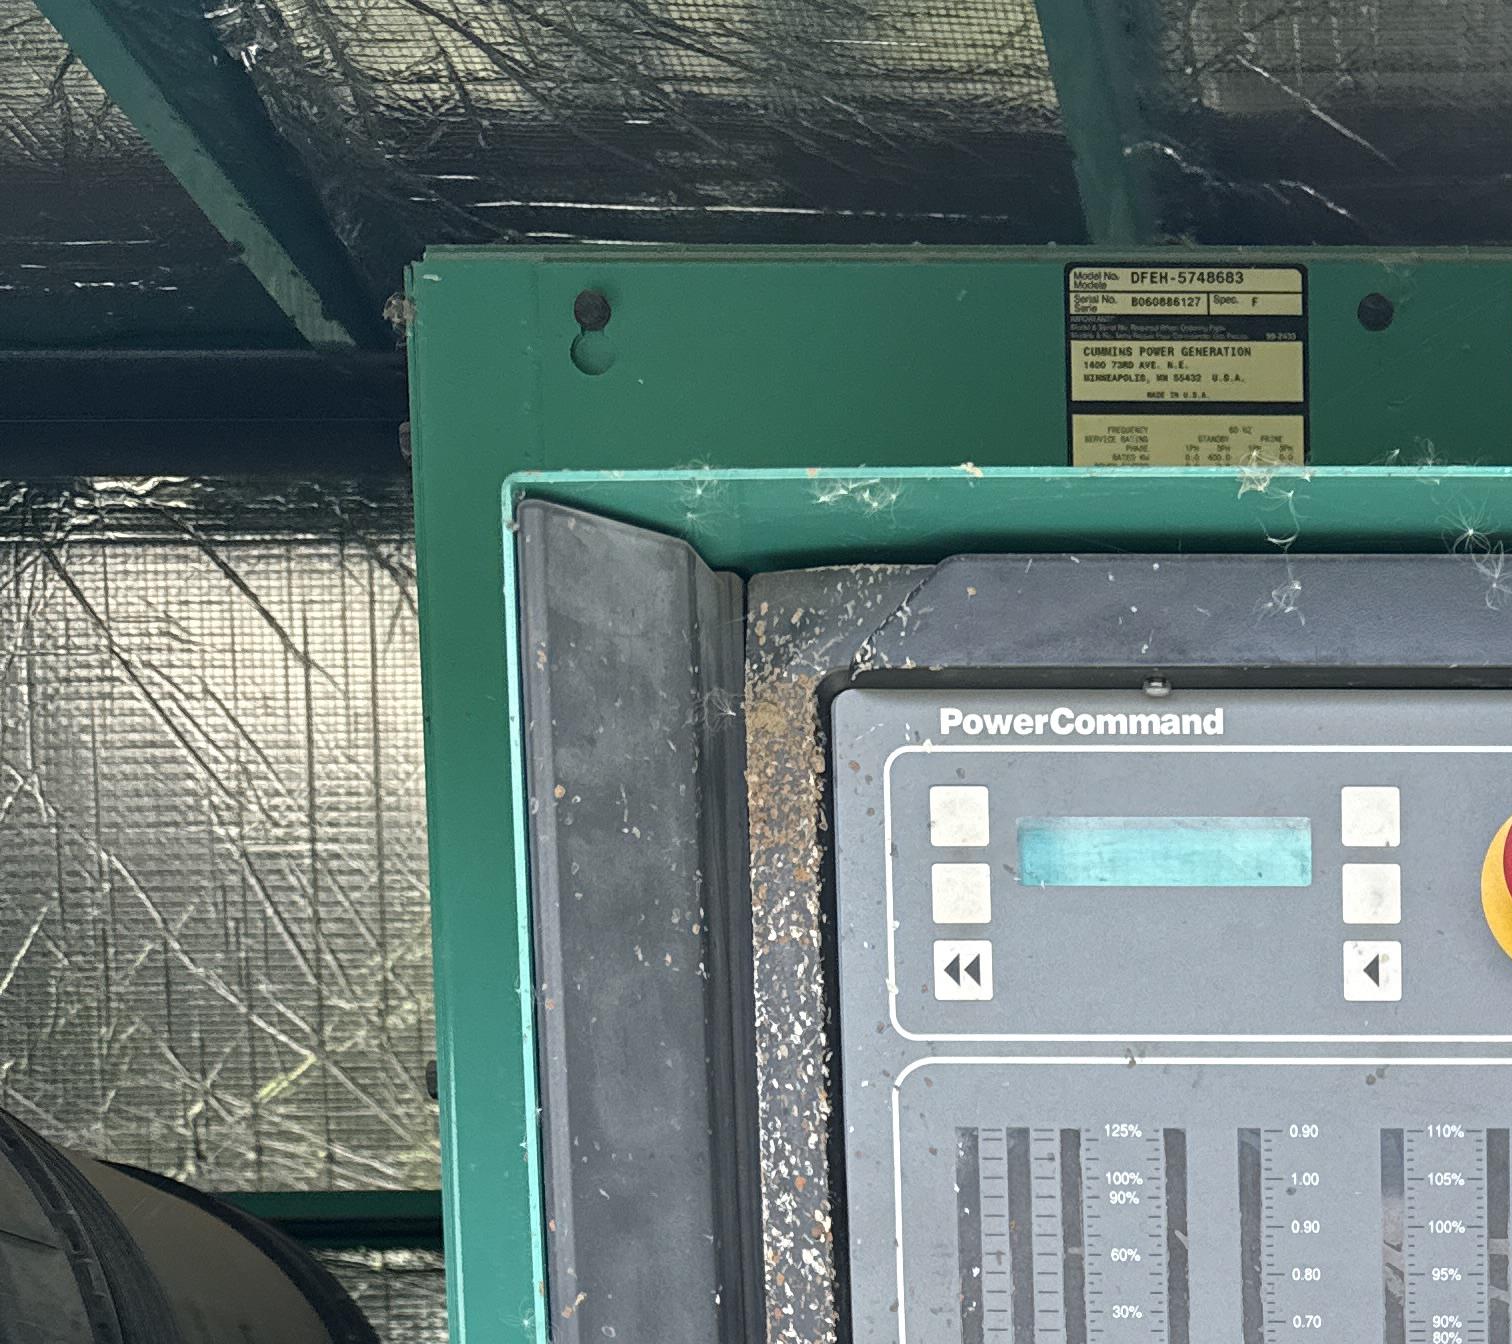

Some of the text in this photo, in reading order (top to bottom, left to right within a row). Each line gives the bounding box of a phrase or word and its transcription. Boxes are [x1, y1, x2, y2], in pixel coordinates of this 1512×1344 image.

[1130, 271, 1244, 285] DFEH-5748683
[1213, 294, 1239, 306] Spec.
[1083, 346, 1252, 357] CUMMINS POWER GENERATION
[939, 707, 1225, 736] PowerCommand
[1104, 1125, 1142, 1138] 125%
[1289, 1125, 1319, 1138] 0.90
[1427, 1125, 1464, 1138] 110%
[1105, 1172, 1143, 1185] 100%
[1291, 1173, 1319, 1186] 1.00
[1427, 1173, 1465, 1186] 105%
[1109, 1191, 1140, 1204] 90%
[1291, 1220, 1320, 1233] 0.90
[1428, 1221, 1466, 1234] 100%
[1110, 1248, 1141, 1261] 60%
[1292, 1268, 1321, 1281] 0.80
[1432, 1268, 1462, 1281] 95%
[1112, 1305, 1142, 1318] 30%
[1293, 1315, 1322, 1328] 0.70
[1432, 1316, 1462, 1328] 90%
[1433, 1332, 1462, 1344] 80%
